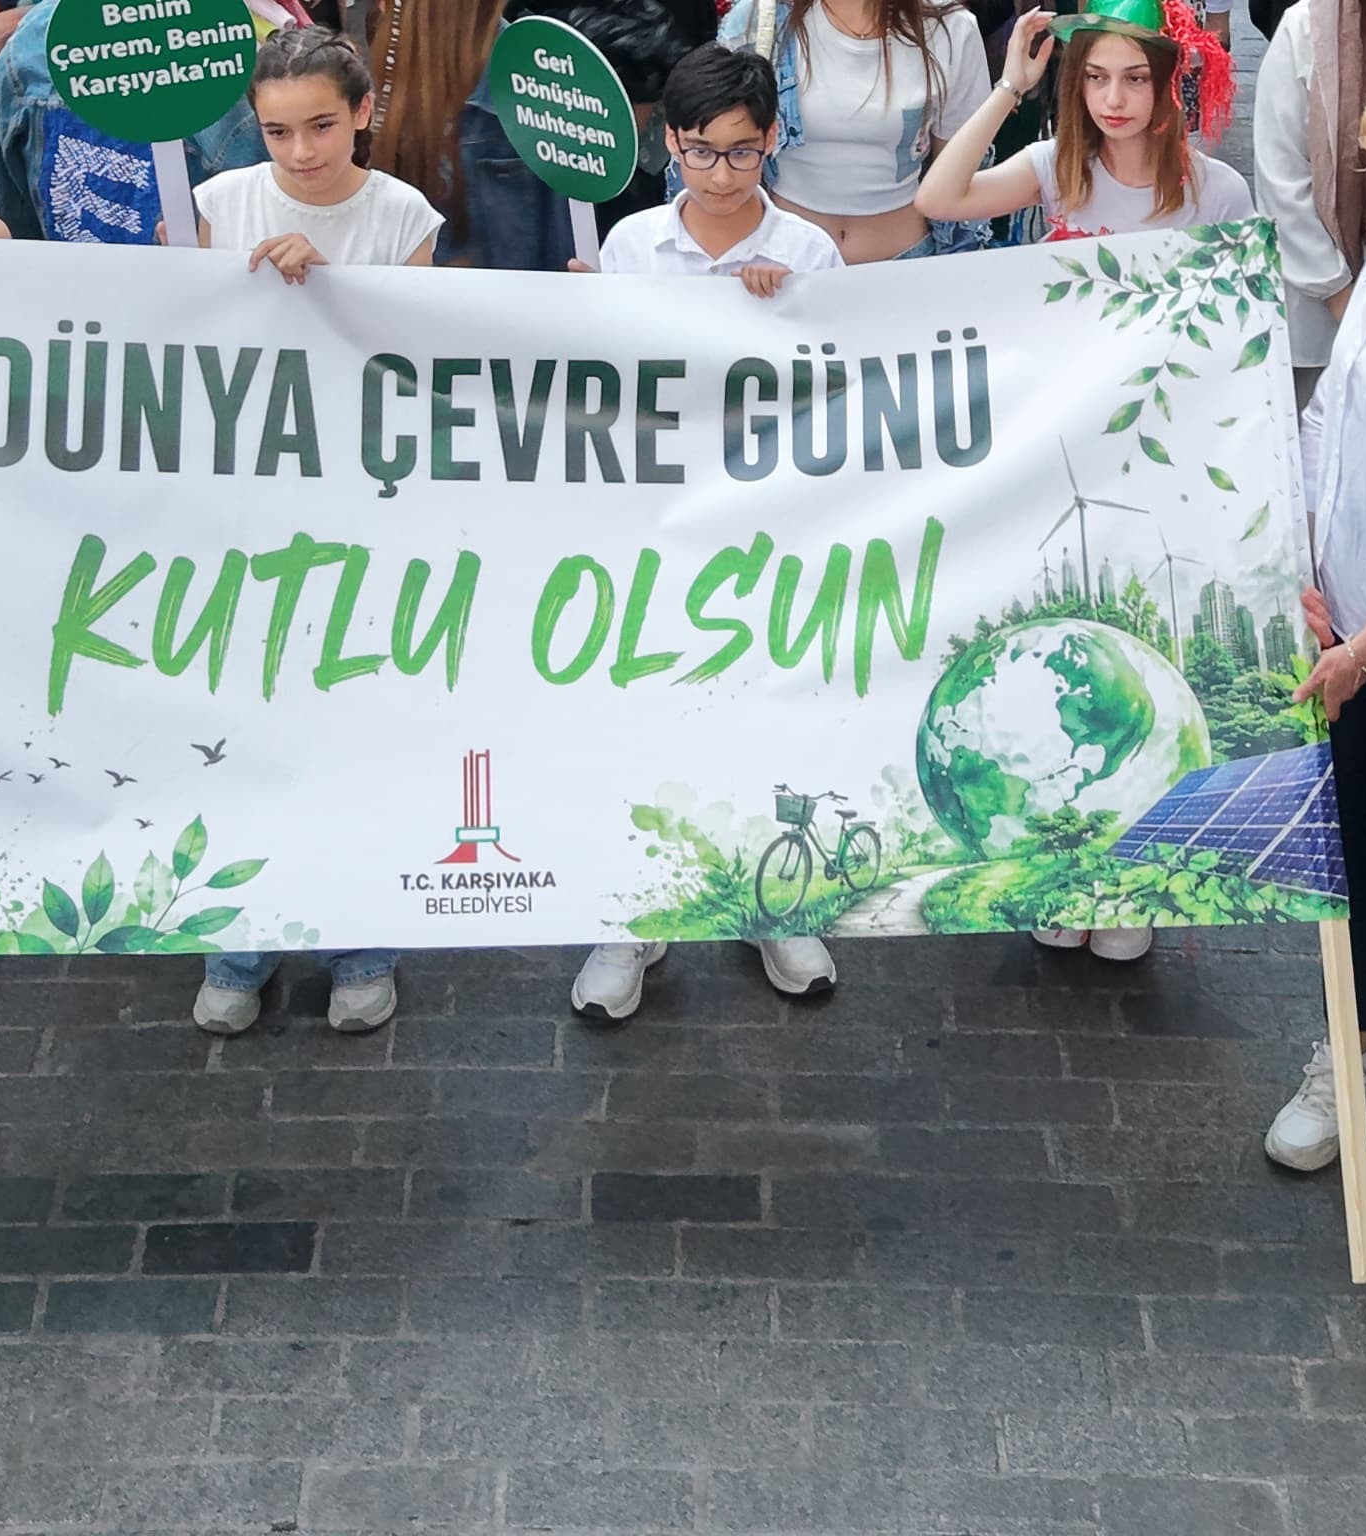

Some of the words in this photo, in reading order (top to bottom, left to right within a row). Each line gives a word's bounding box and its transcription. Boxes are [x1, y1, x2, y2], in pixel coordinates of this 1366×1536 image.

[50, 37, 162, 71] Çevrem,
[166, 21, 253, 50] Benim
[534, 48, 575, 76] Geri
[69, 53, 245, 98] Karşıyaka'm!
[510, 73, 609, 119] Dönüşüm,
[516, 104, 616, 148] Muhteşem
[536, 140, 607, 177] Olacak!
[361, 352, 688, 499] ÇEVRE
[723, 326, 992, 479] GÜNÜ
[49, 530, 483, 718] KUTLU
[531, 516, 945, 699] OLSUN
[399, 873, 434, 890] T.C.
[441, 871, 557, 893] KARŞIYAKA
[426, 893, 533, 915] BELEDİYESİ
